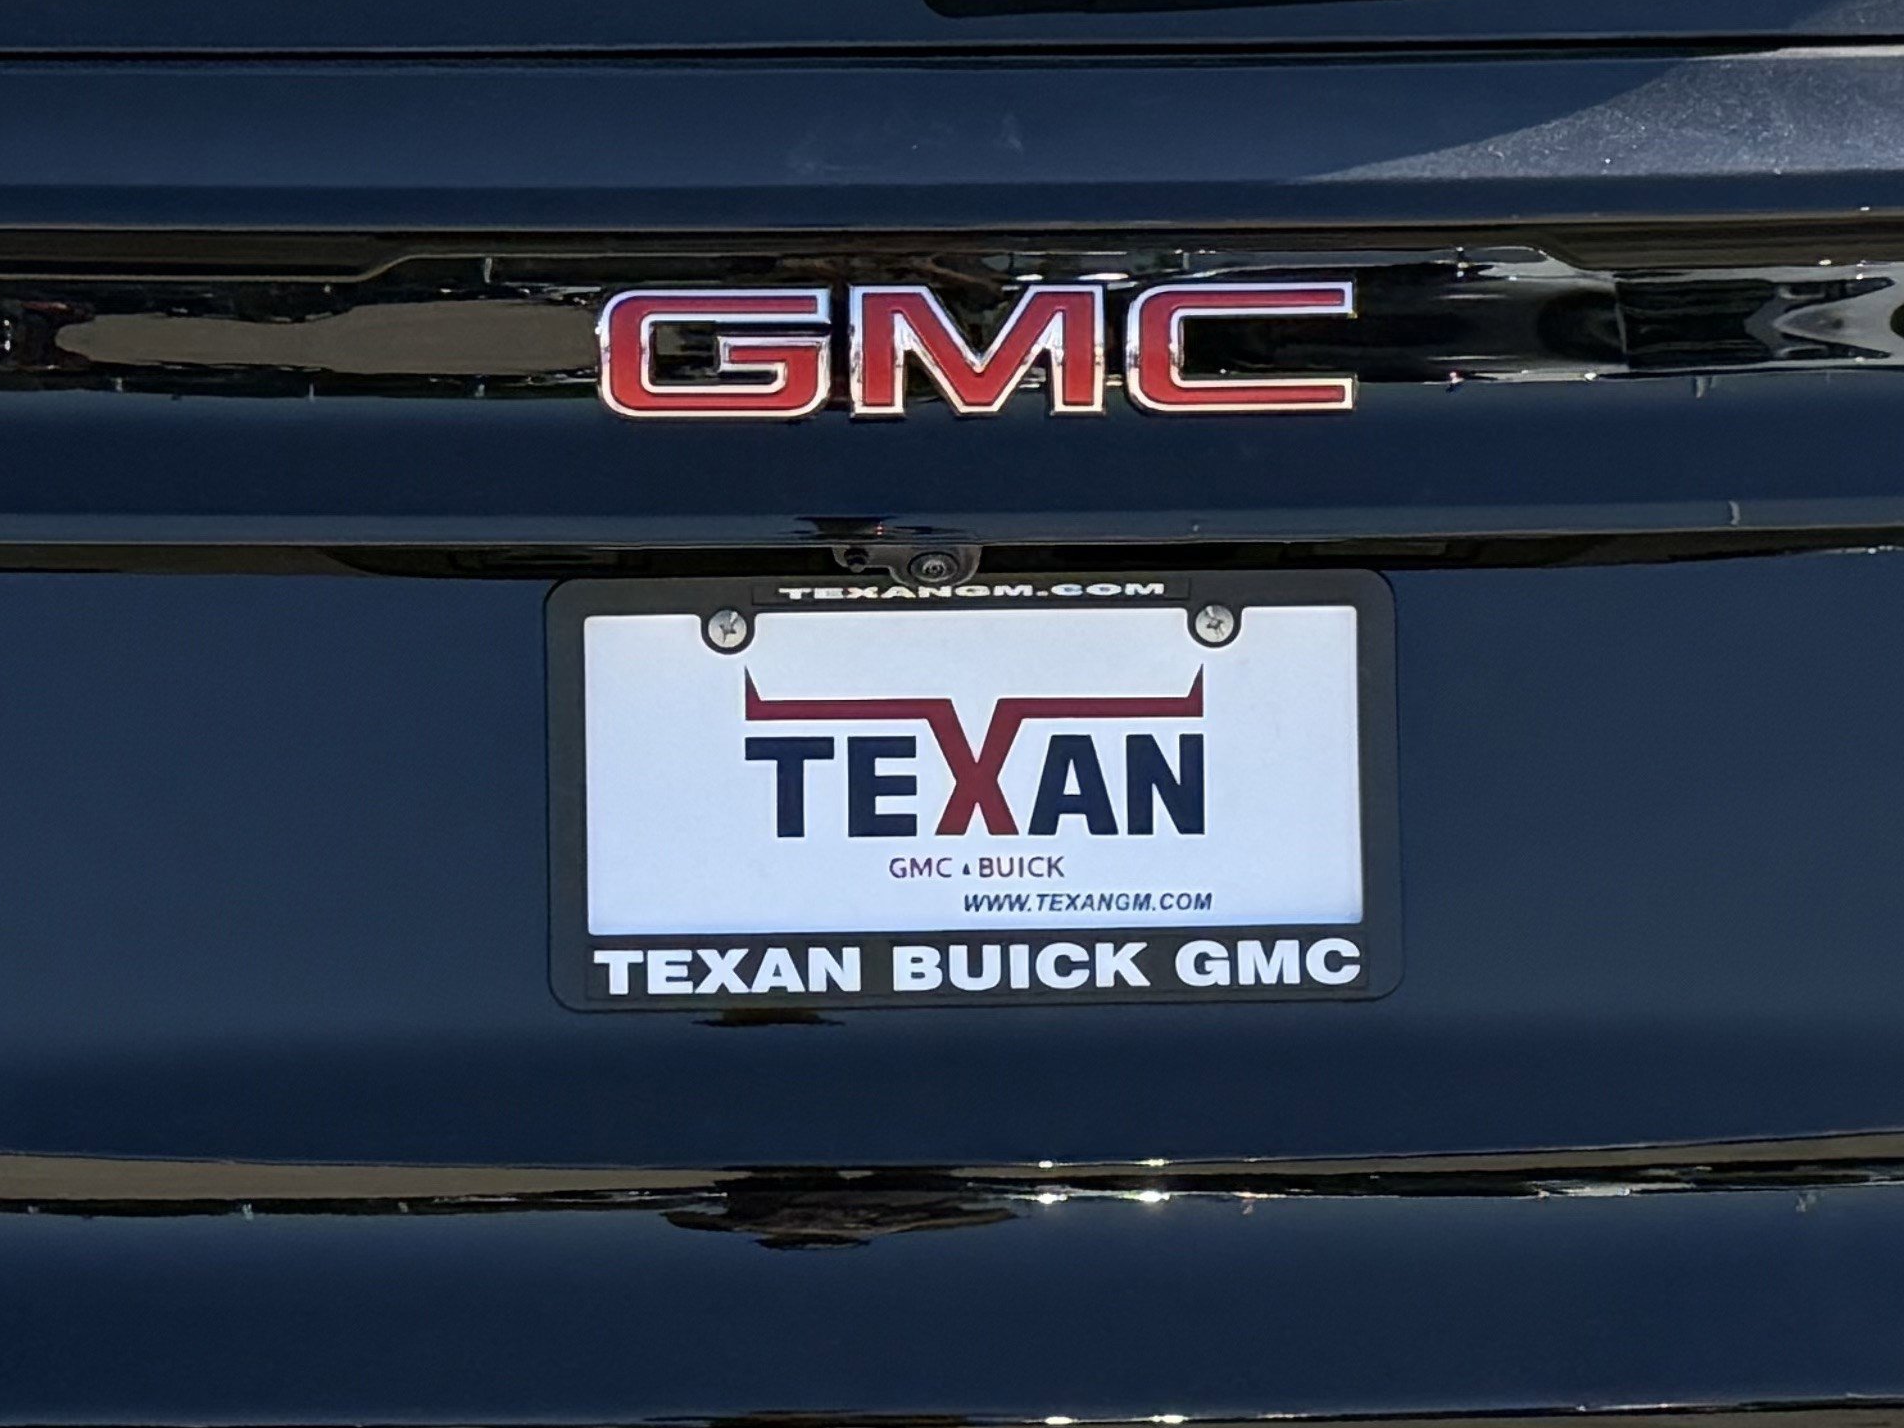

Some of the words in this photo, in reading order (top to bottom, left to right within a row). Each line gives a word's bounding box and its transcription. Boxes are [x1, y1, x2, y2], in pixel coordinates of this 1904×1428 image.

[596, 281, 1359, 420] GMC
[778, 583, 1165, 600] TEXANGM.COM
[744, 698, 1206, 838] TEXAN
[889, 857, 953, 879] GMC
[978, 855, 1066, 879] BUICK
[963, 892, 1213, 913] WWW.TEXANGM.COM
[593, 947, 862, 996] TEXAN
[892, 942, 1151, 992] BUICK
[1174, 938, 1362, 988] GMC
